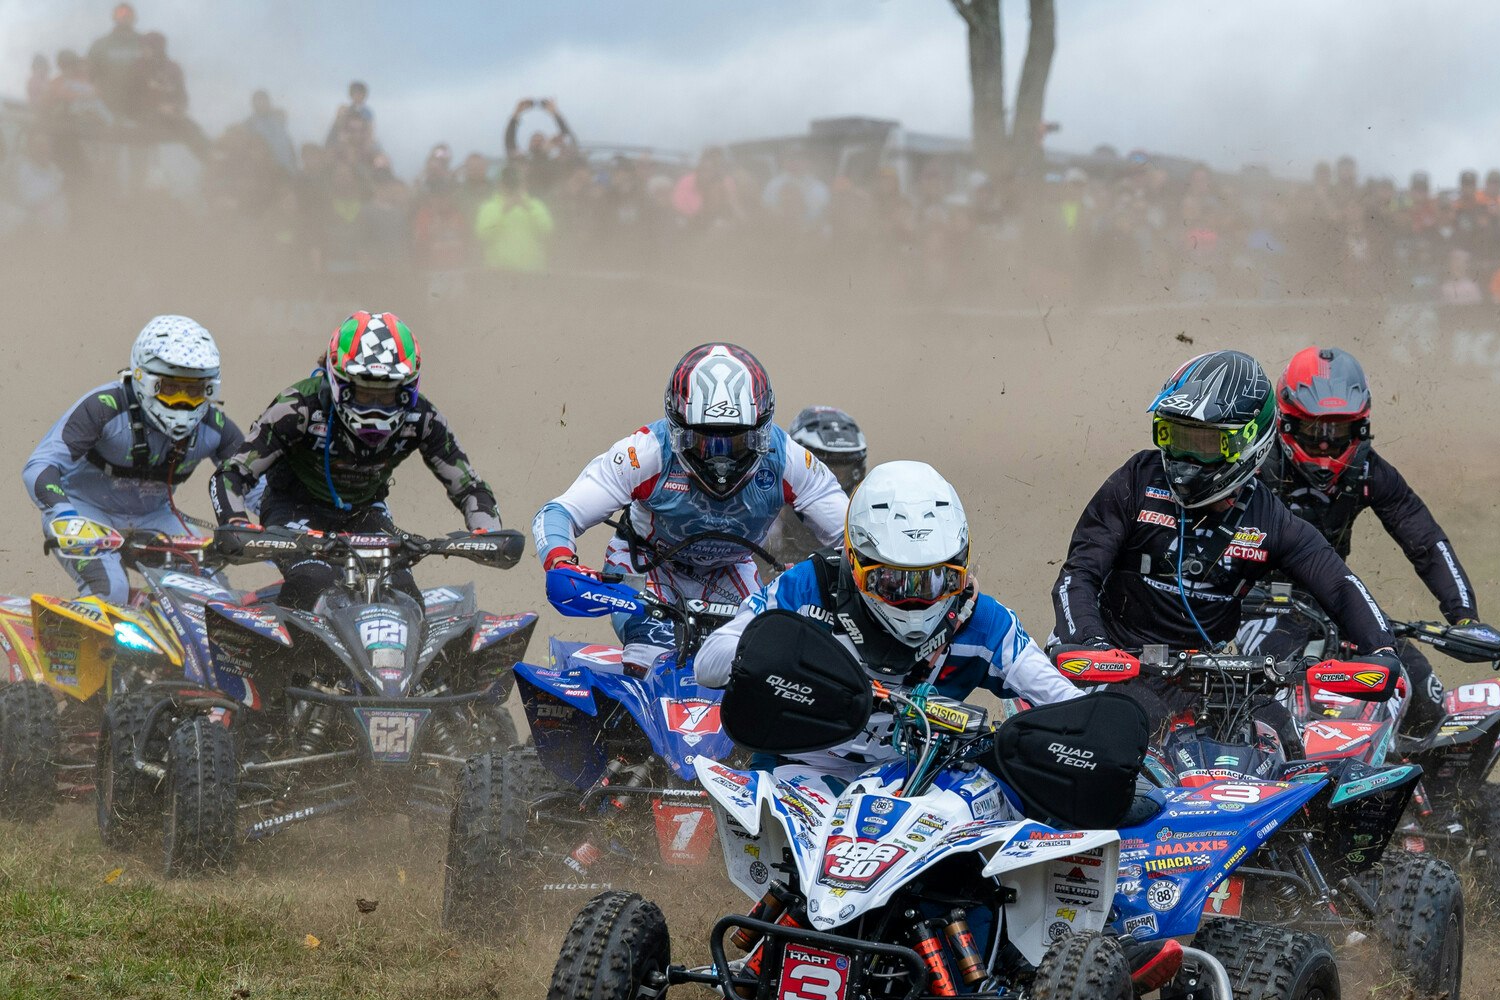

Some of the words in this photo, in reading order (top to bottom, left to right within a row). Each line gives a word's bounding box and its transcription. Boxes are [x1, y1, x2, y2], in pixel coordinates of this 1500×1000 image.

[664, 482, 690, 492] MOTUL
[1138, 510, 1177, 528] KEND
[245, 539, 297, 549] ACERBIS
[350, 534, 390, 543] flexx
[446, 542, 498, 551] ACERBIS
[580, 590, 638, 612] ACERBIS
[360, 619, 407, 649] 621
[914, 628, 948, 662] LEATT
[1099, 663, 1125, 671] CYCRA
[766, 675, 813, 695] QUAD
[1321, 673, 1345, 682] CYCRA
[565, 689, 590, 697] MOTUL
[773, 686, 816, 707] TECH
[679, 705, 712, 731] 1
[369, 717, 415, 752] 621
[1048, 742, 1094, 760] QUAD
[1056, 753, 1097, 771] TECH
[662, 789, 702, 797] FACTORY
[1211, 784, 1261, 804] 3
[253, 806, 315, 831] HOUSER
[670, 810, 704, 851] 1
[1029, 831, 1085, 841] MAXXIS
[827, 840, 899, 863] 488
[1155, 840, 1230, 856] MAXXIS
[829, 859, 881, 879] 30
[1145, 856, 1193, 872] ITHACA
[1055, 884, 1099, 897] METHOD
[1156, 889, 1171, 903] 88
[790, 952, 831, 965] HART
